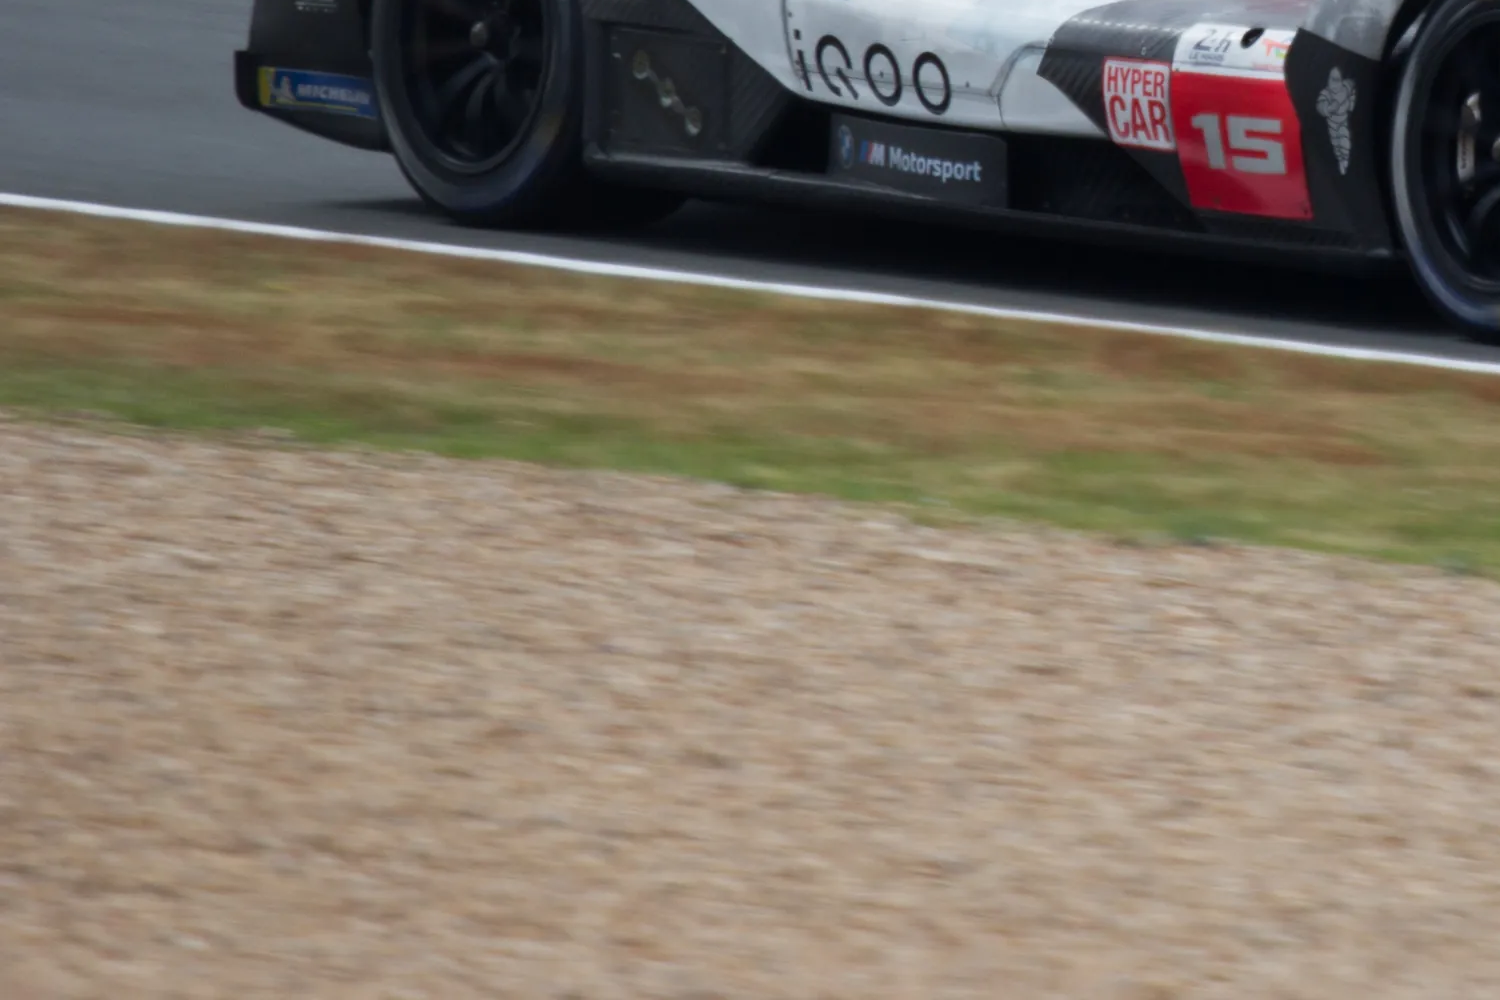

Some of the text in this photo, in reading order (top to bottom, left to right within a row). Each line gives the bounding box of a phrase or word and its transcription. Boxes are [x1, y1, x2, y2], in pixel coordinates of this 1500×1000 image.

[1192, 28, 1232, 54] 2h
[1106, 65, 1166, 99] HYPER
[1108, 95, 1172, 143] CAR
[1190, 112, 1288, 175] 15
[888, 145, 983, 184] Motorsport
